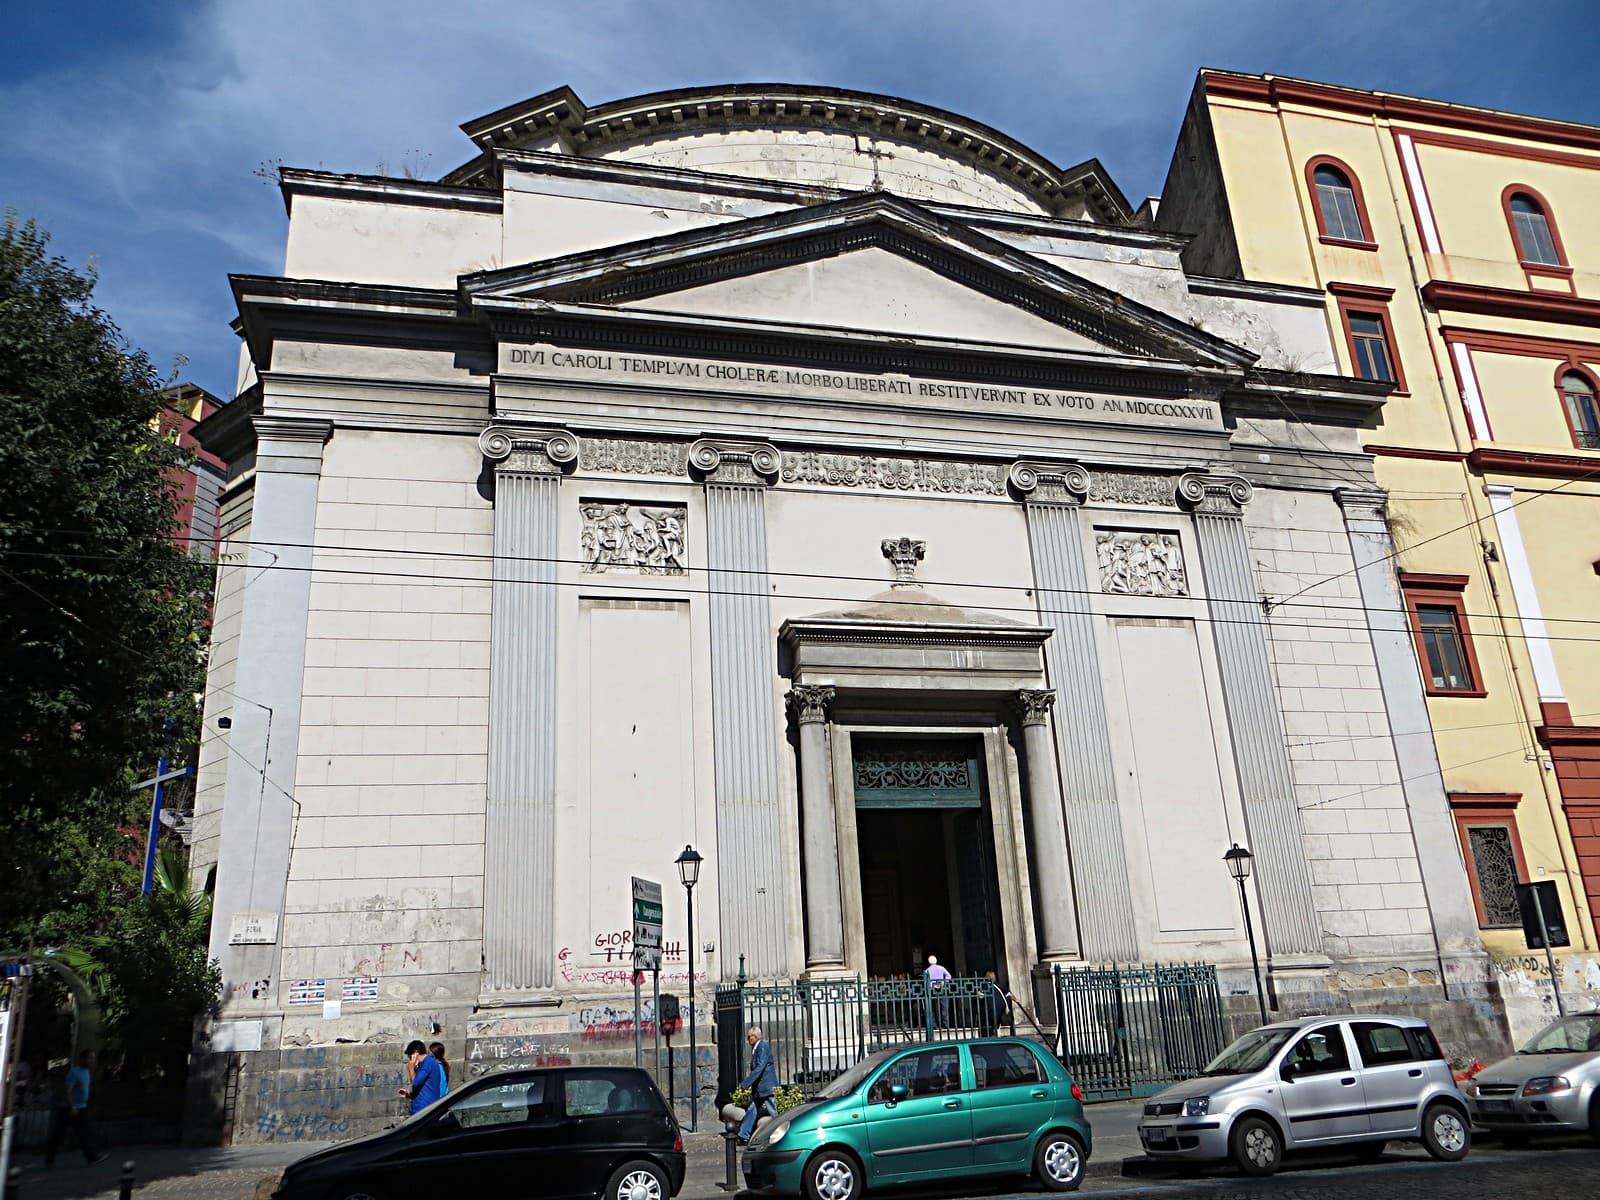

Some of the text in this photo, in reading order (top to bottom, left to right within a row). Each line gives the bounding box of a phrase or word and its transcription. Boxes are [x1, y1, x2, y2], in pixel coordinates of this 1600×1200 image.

[511, 349, 545, 366] DIVI
[551, 352, 612, 371] CAROLI
[620, 357, 700, 378] TEMPLVM
[706, 364, 779, 383] CHOLERÆ
[785, 370, 844, 389] MORBO
[846, 375, 913, 395] LIBERATI
[919, 383, 1027, 406] RESTITVERVNT
[1033, 392, 1051, 407] EX
[1056, 395, 1095, 410] VOTO
[1126, 400, 1214, 421] MDCCCXXXVII
[595, 930, 635, 947] GIOR
